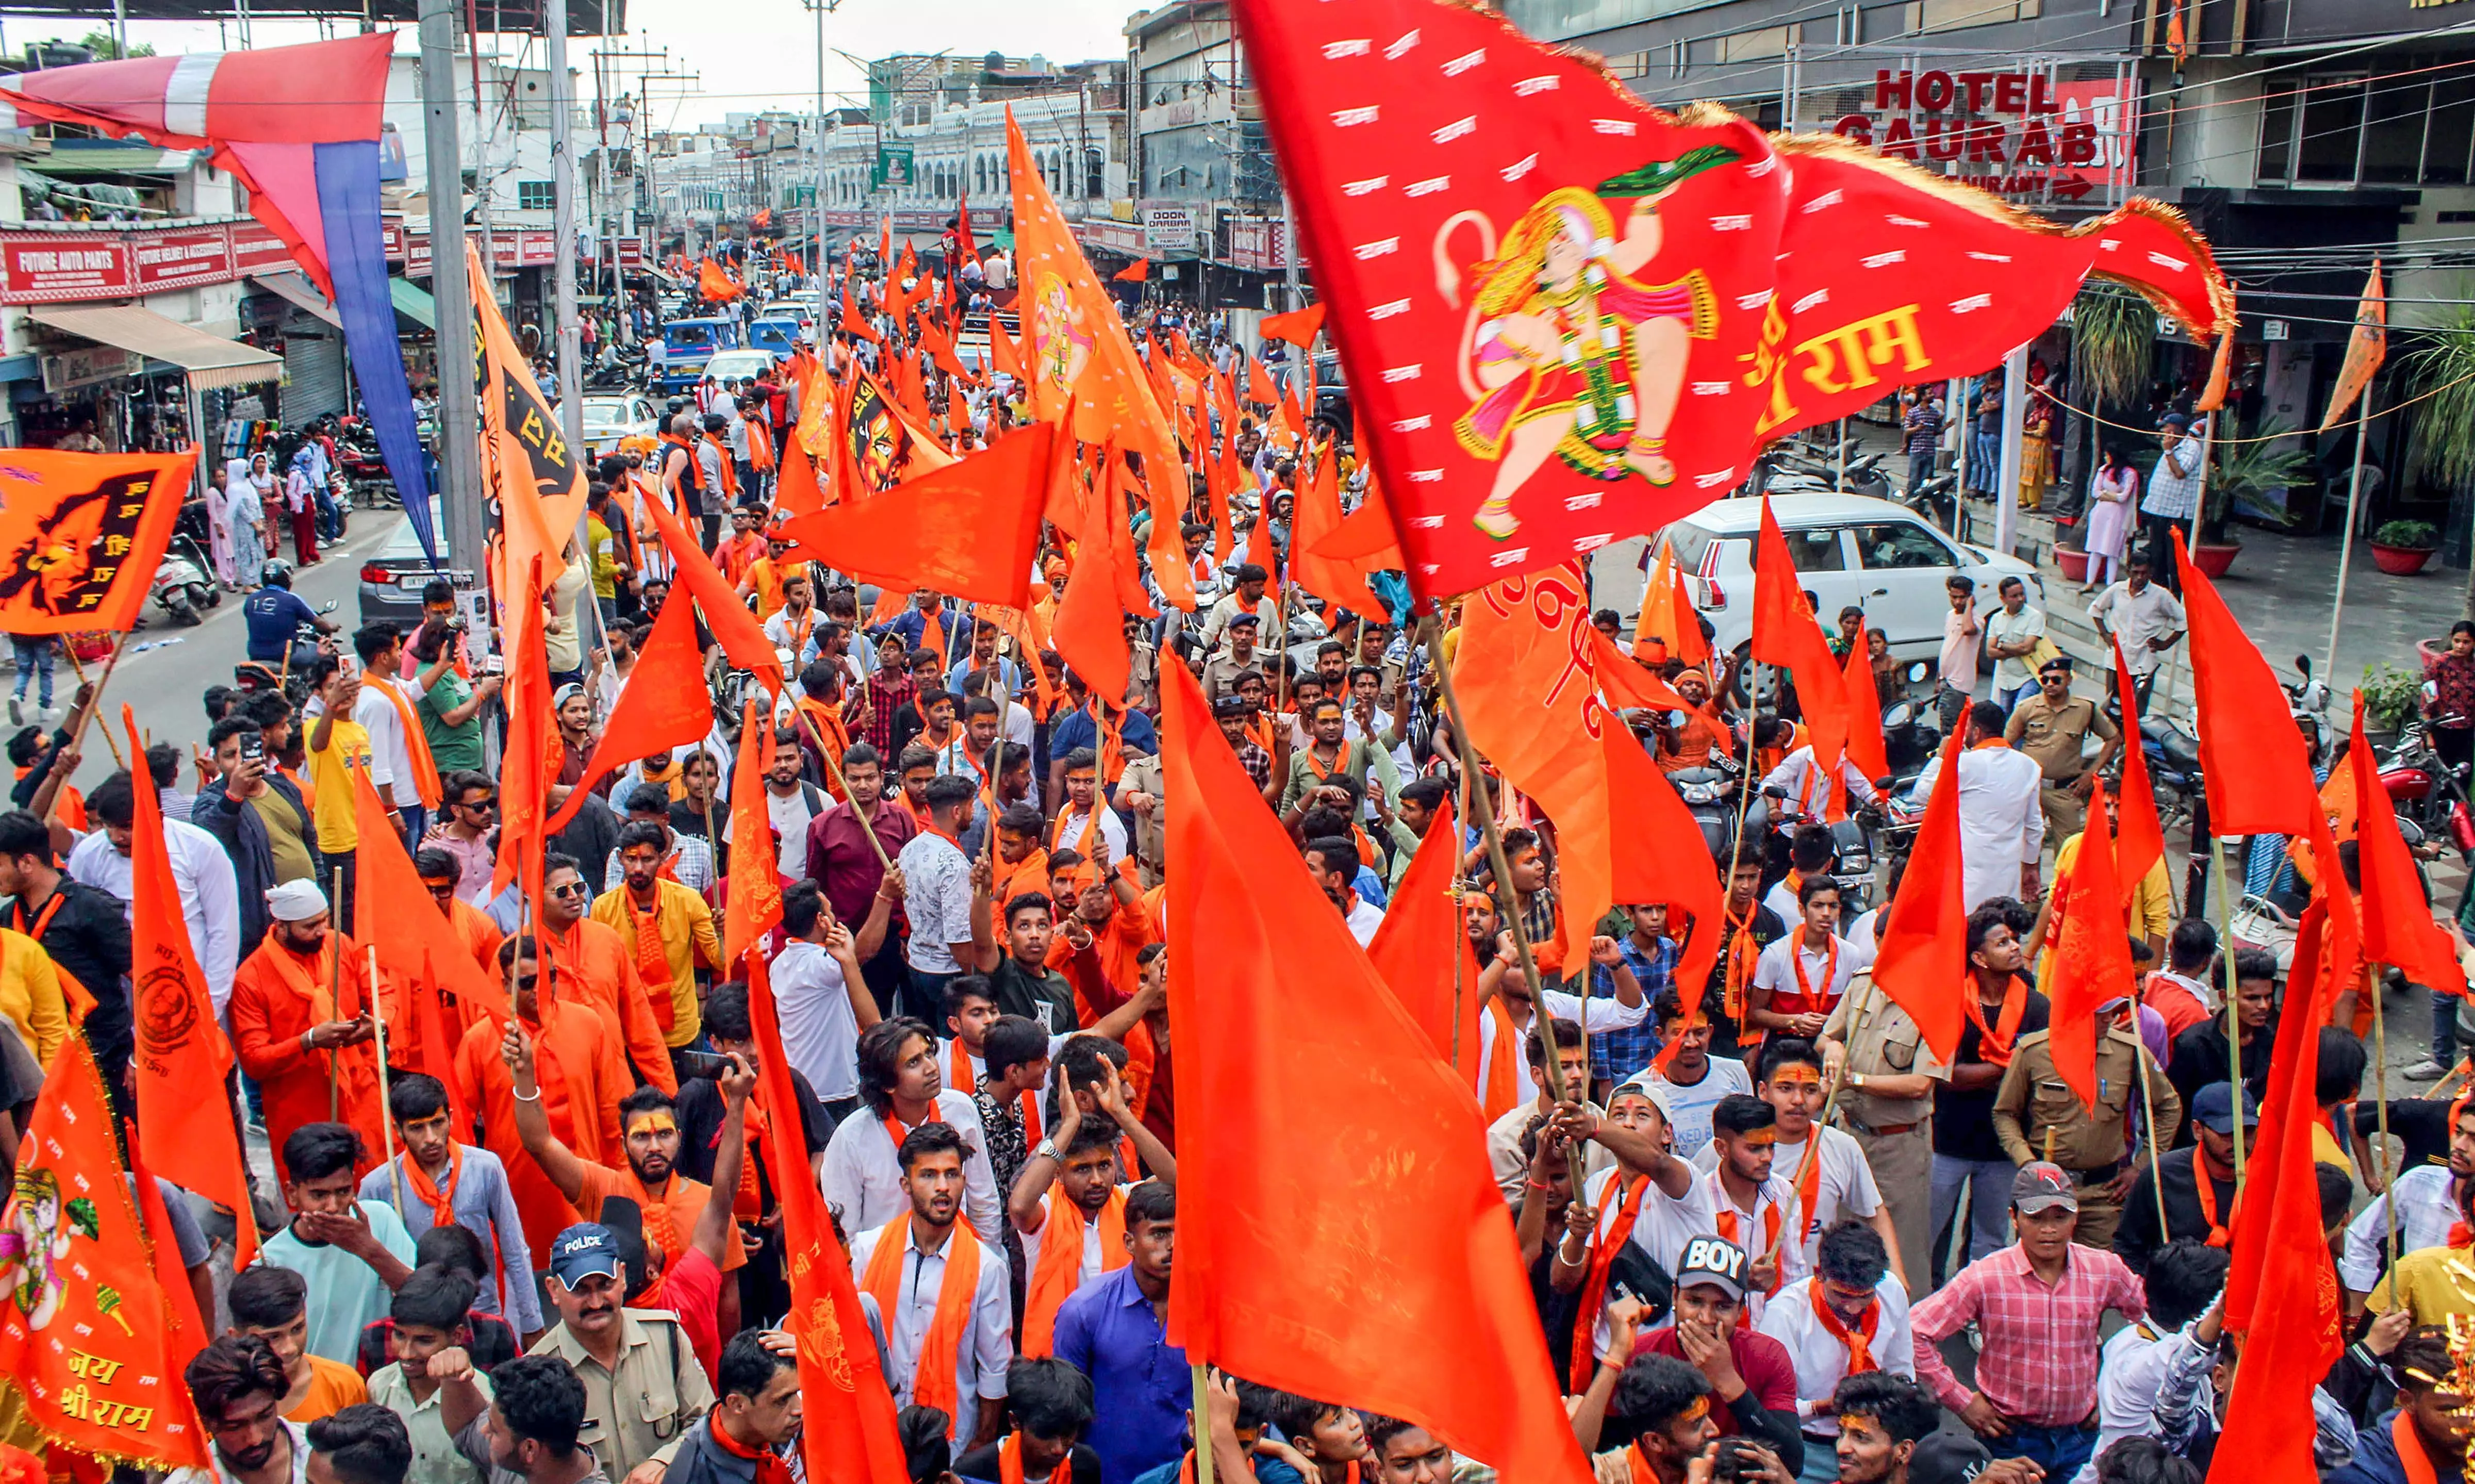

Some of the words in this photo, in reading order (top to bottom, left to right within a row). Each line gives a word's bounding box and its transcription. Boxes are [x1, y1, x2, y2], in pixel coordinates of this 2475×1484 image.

[1875, 69, 2059, 113] HOTEL
[1834, 115, 2098, 164] GAURAB
[1153, 211, 1186, 219] DOON
[18, 252, 57, 272] FUTURE
[58, 251, 83, 270] AUTO
[84, 250, 113, 269] PARTS
[138, 249, 161, 265] FUTURE
[1792, 302, 1933, 394] राम
[853, 381, 876, 420] जय
[1564, 492, 1605, 511] राम
[1490, 547, 1530, 568] राम
[61, 1101, 77, 1125] राम
[46, 1136, 63, 1160] राम
[74, 1173, 91, 1193] राम
[565, 1235, 602, 1254] POLICE
[1686, 1240, 1744, 1279] BOY
[72, 1262, 89, 1281] राम
[68, 1347, 124, 1385] जय
[138, 1375, 159, 1386] राम
[60, 1383, 91, 1420] श्री
[93, 1399, 154, 1432] राम
